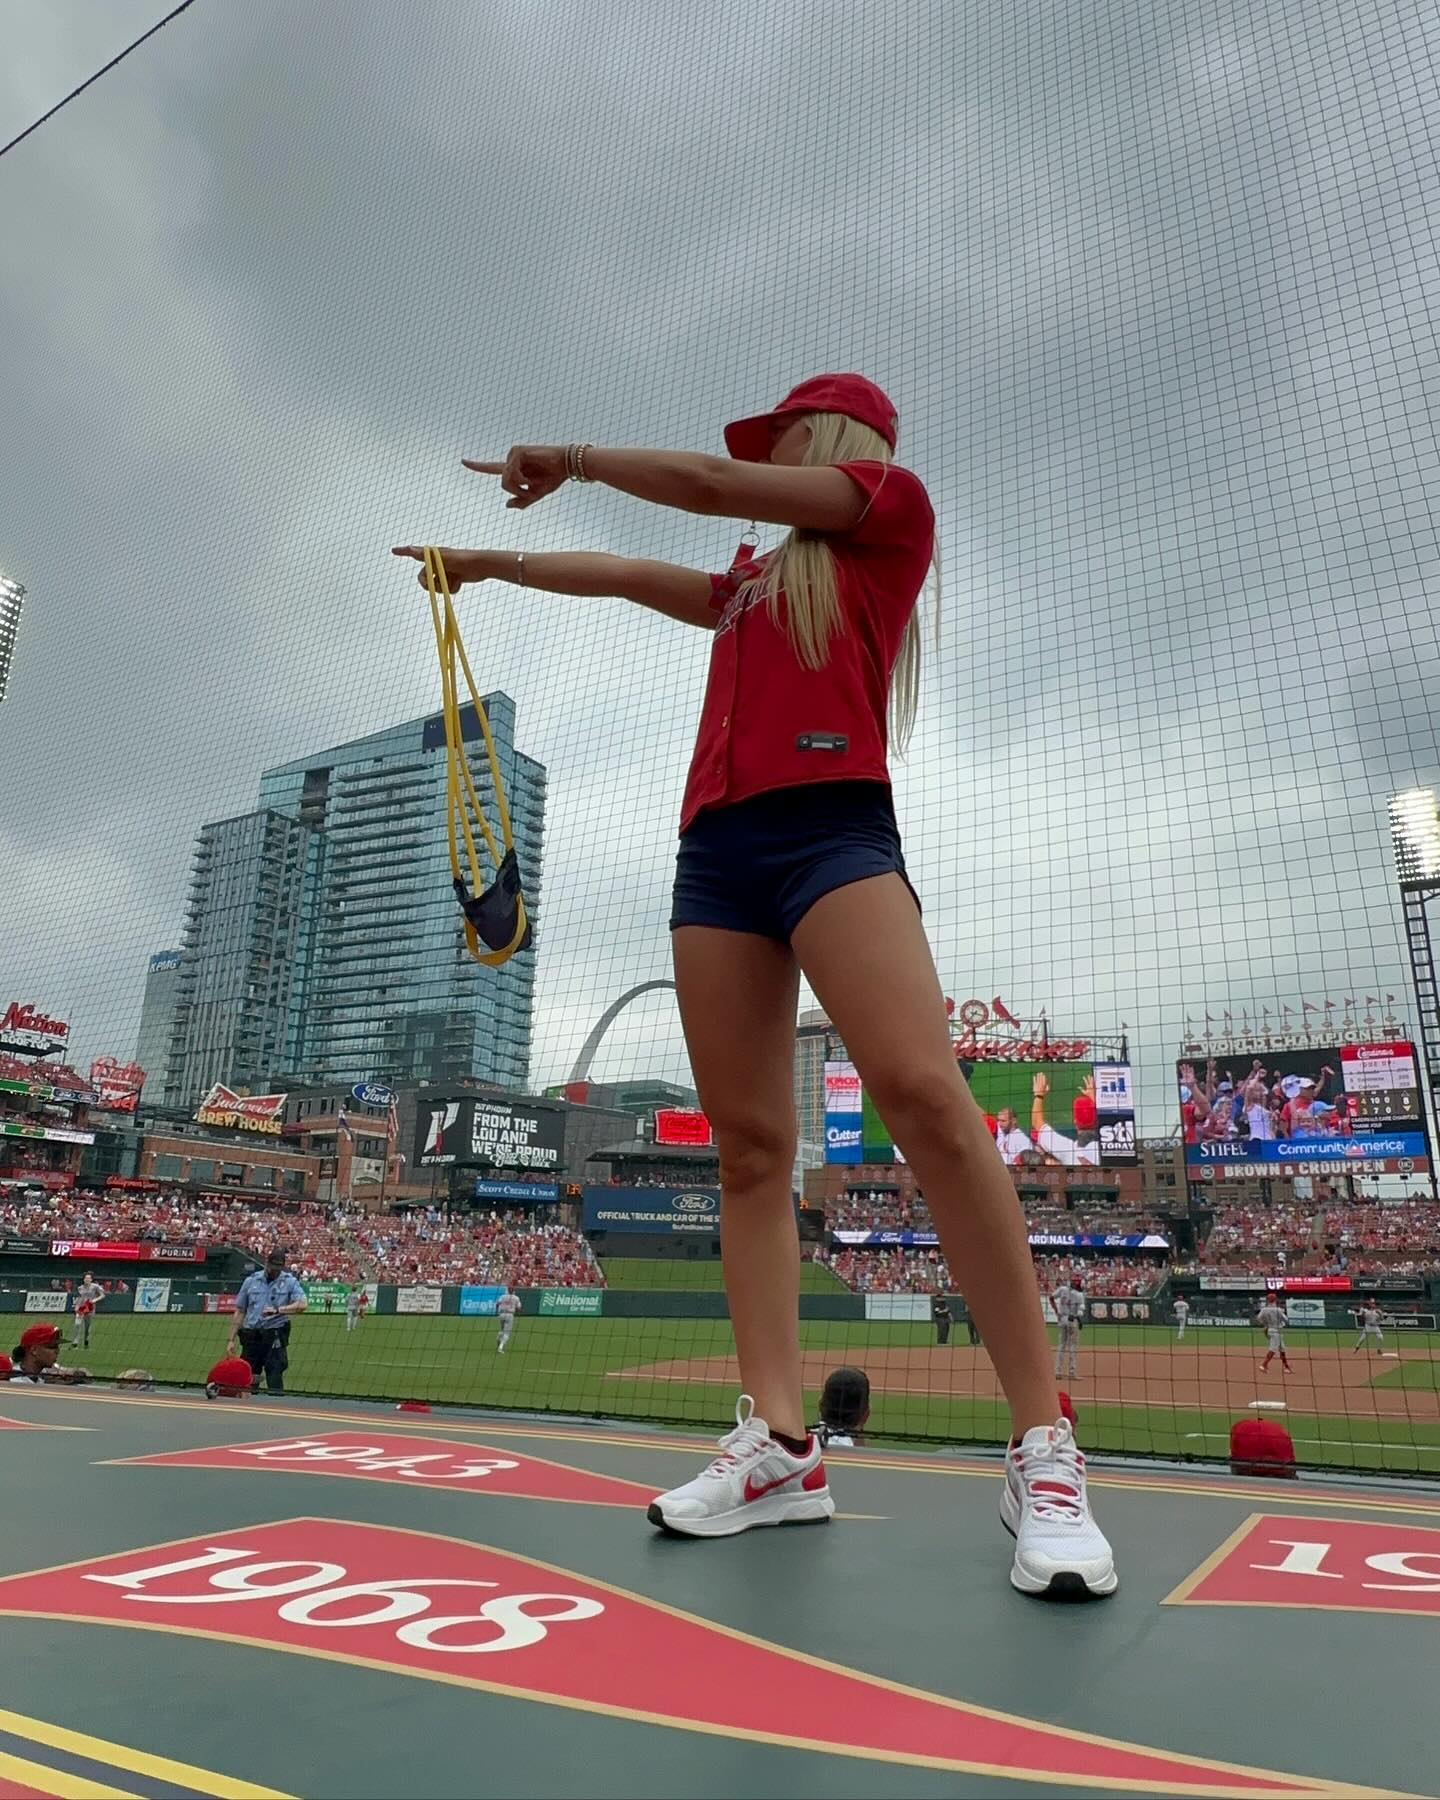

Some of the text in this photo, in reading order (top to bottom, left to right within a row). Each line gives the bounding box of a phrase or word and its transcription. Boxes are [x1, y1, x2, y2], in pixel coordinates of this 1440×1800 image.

[1200, 1030, 1386, 1053] WORLD CHAMPIONS
[203, 1090, 283, 1116] Budweiser
[361, 1085, 391, 1104] Ford
[197, 1110, 283, 1135] BREW HOUSE
[473, 1112, 538, 1133] FROM THE
[472, 1126, 529, 1145] LOU AND
[827, 1126, 862, 1142] Cutter
[1101, 1142, 1135, 1150] TODAY
[1223, 1159, 1385, 1177] BROWN & CROUPPEN
[680, 1196, 708, 1209] Ford
[597, 1211, 631, 1220] OFFICIAL
[631, 1212, 656, 1221] TRUCK
[655, 1213, 673, 1221] AND
[672, 1213, 687, 1222] CAR
[688, 1214, 699, 1222] OF
[699, 1214, 713, 1222] THE
[52, 1243, 71, 1256] UP
[161, 1248, 194, 1257] PURINA
[1267, 1281, 1284, 1290] UP
[555, 1294, 600, 1306] National
[1214, 1318, 1251, 1326] STADIUM
[229, 1440, 520, 1478] 1943
[80, 1547, 606, 1653] 1968
